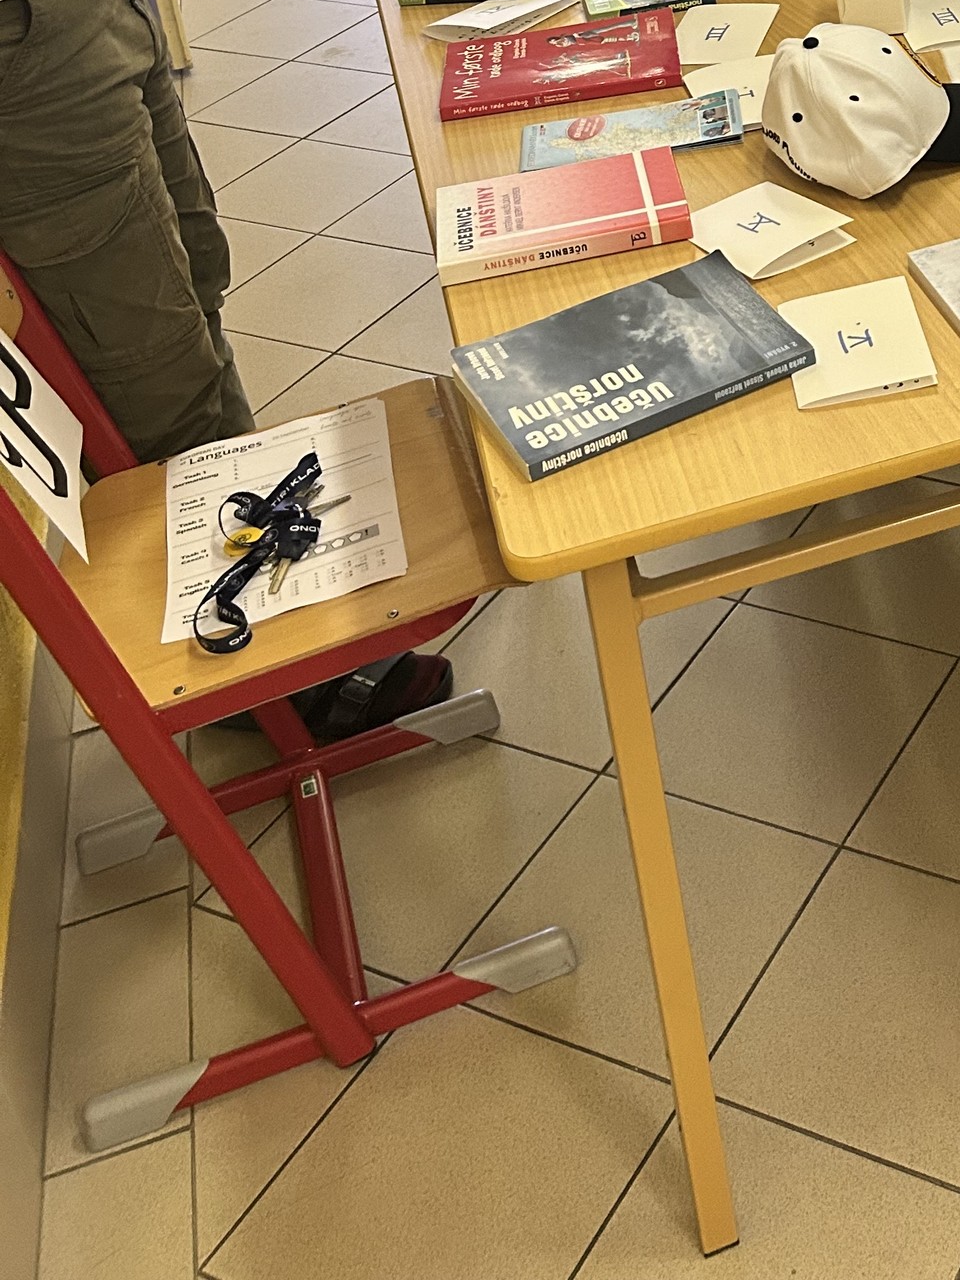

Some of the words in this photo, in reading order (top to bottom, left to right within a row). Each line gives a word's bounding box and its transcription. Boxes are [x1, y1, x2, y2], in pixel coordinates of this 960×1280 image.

[455, 43, 485, 78] første
[488, 40, 512, 63] ordbog
[453, 76, 480, 100] Min
[473, 185, 498, 238] DÁNŠTINY
[453, 205, 475, 252] UČEBNICE
[539, 243, 588, 261] UČEBNICE
[483, 253, 536, 271] DÁNŠTINY
[788, 356, 807, 374] Jarka
[744, 371, 764, 389] Sissel
[508, 363, 646, 431] norštiny
[524, 380, 676, 451] Učebnice
[582, 429, 629, 455] Učebnice
[189, 440, 263, 465] Languages
[541, 446, 583, 474] norštiny
[184, 471, 201, 480] Task
[179, 502, 207, 513] French
[180, 499, 198, 507] Task
[176, 523, 207, 535] Spanish
[179, 520, 197, 528] Task
[181, 552, 199, 560] Task
[178, 586, 209, 598] English
[183, 582, 203, 590] Task
